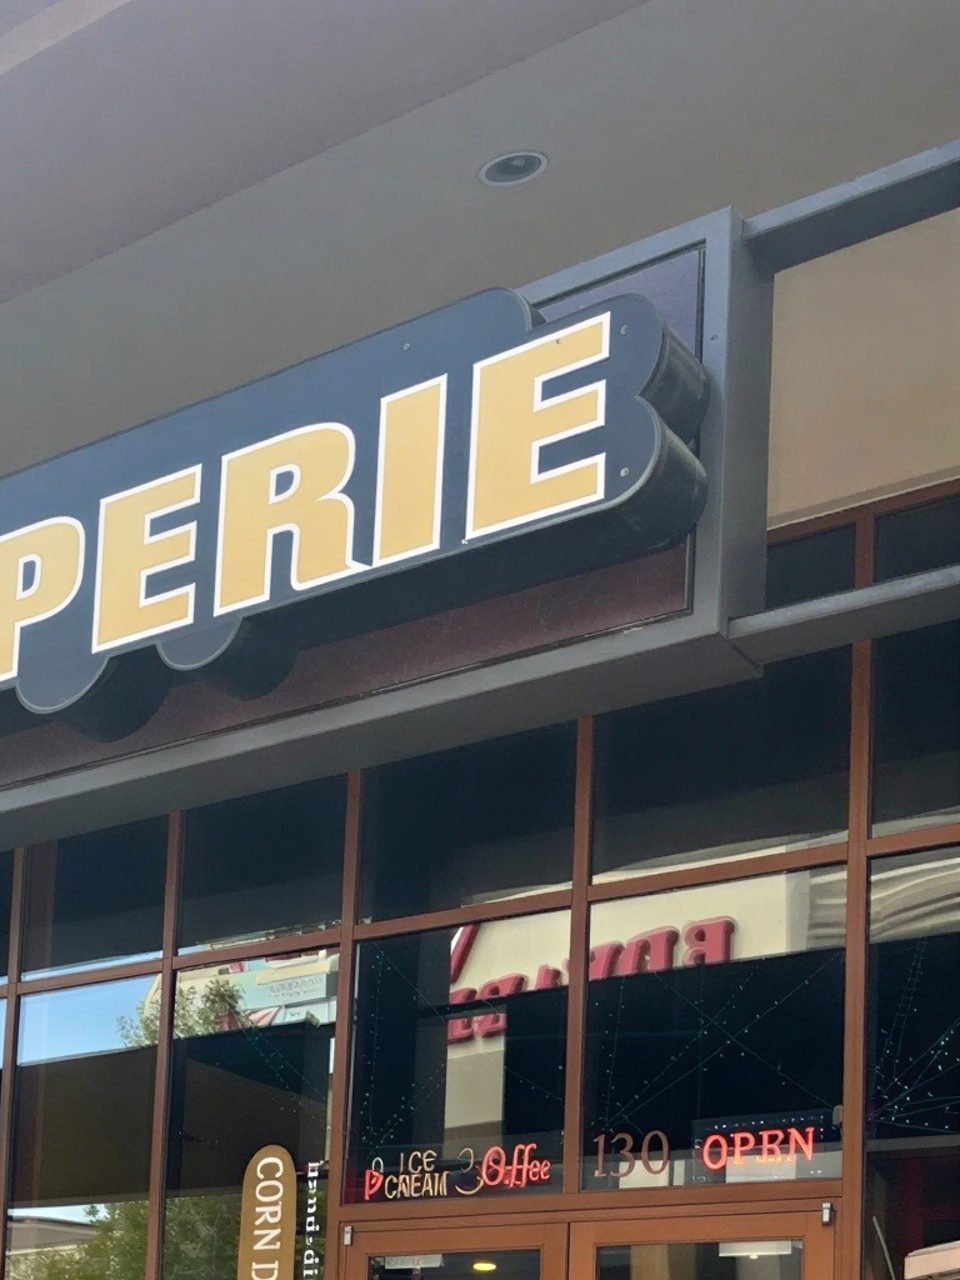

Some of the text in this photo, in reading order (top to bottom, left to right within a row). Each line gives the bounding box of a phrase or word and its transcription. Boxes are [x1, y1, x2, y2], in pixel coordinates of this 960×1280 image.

[400, 1150, 437, 1173] ICE
[593, 1129, 669, 1177] 130
[253, 1155, 284, 1252] CORN
